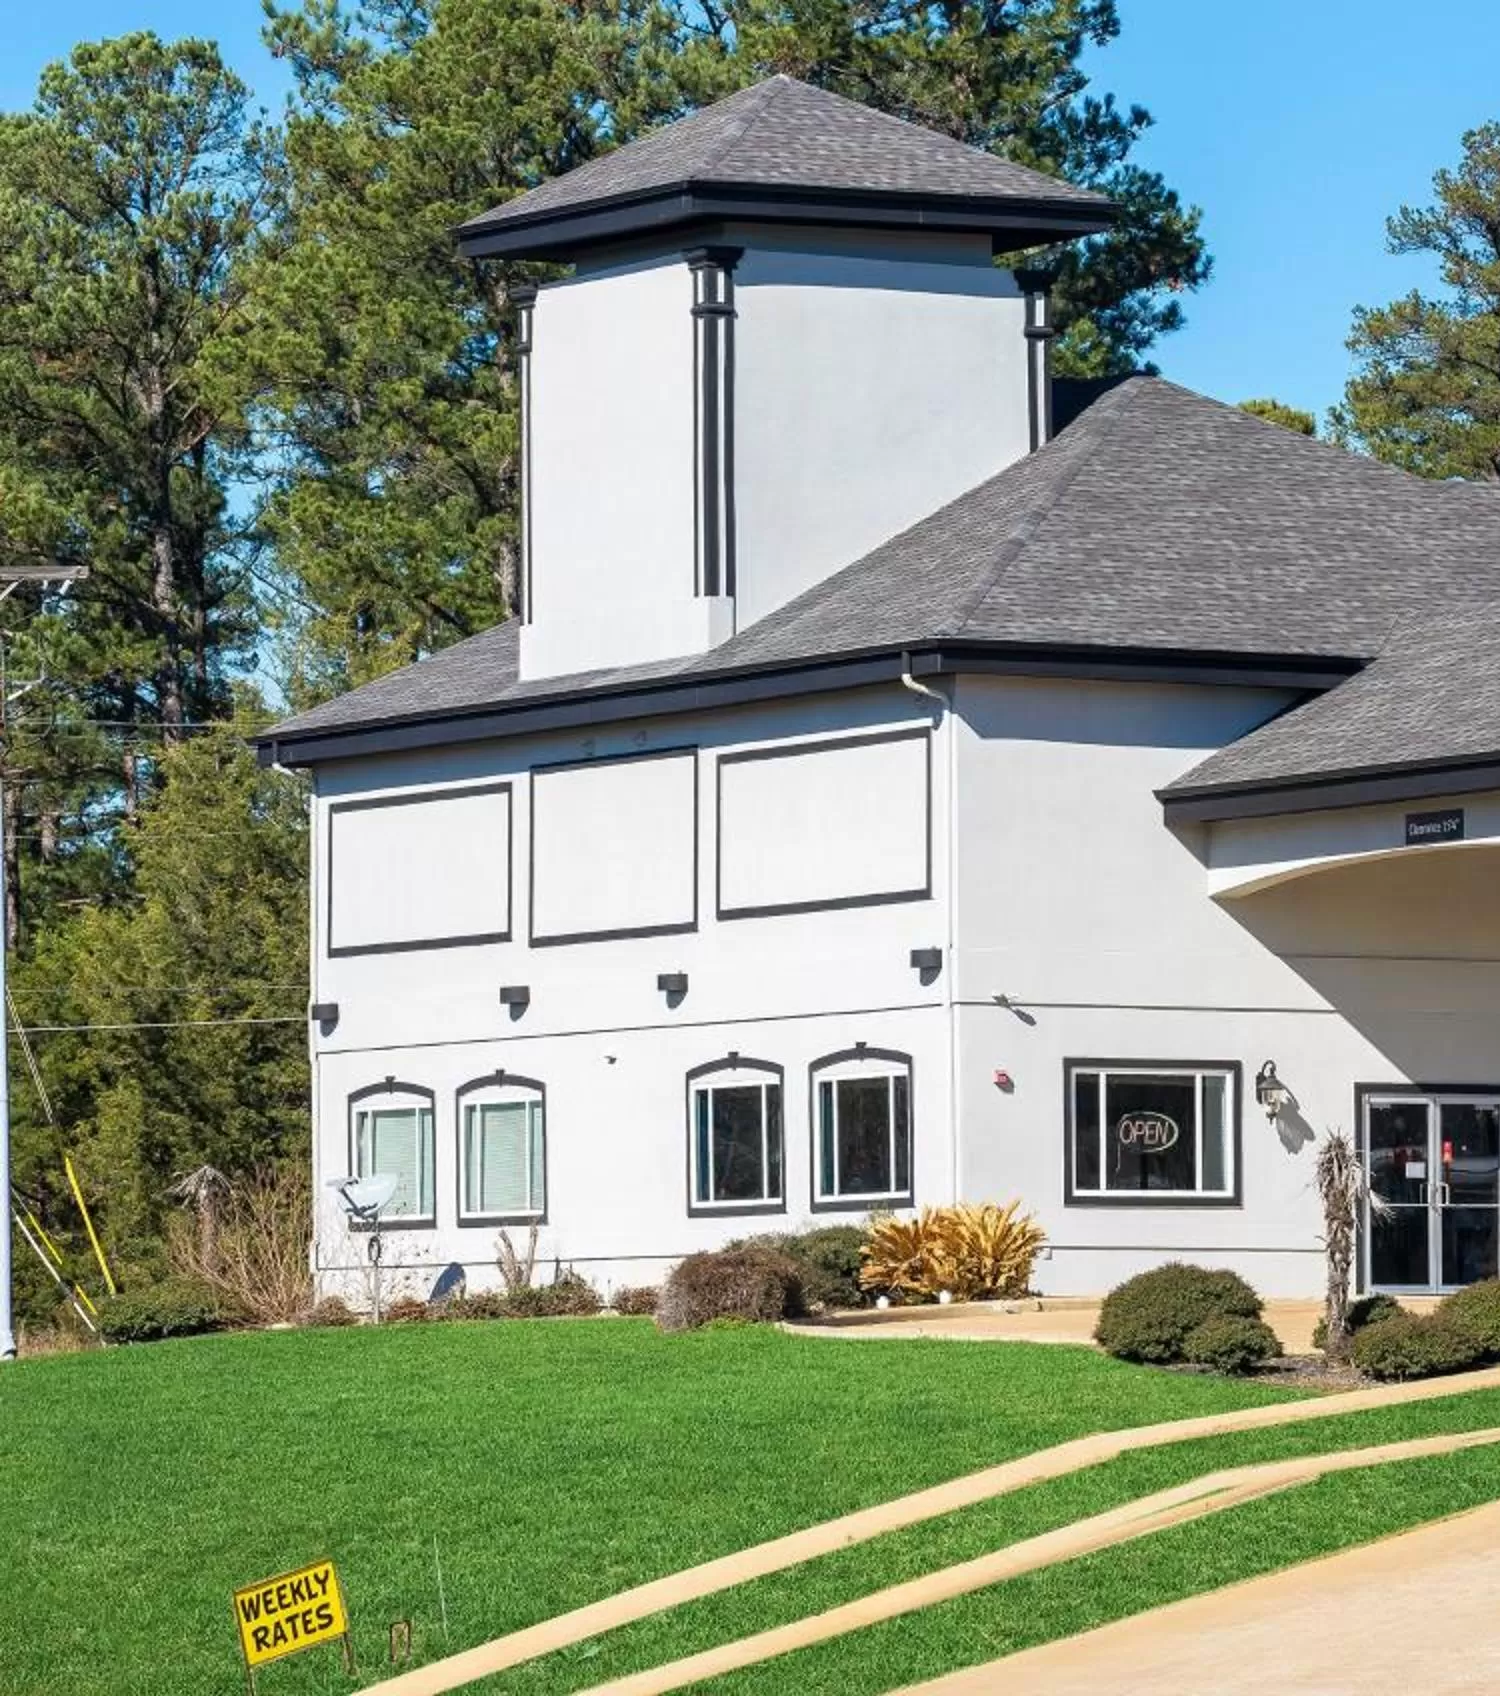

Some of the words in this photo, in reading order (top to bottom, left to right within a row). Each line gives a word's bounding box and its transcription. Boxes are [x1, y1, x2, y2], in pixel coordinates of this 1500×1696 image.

[1119, 1120, 1169, 1144] OPEN
[240, 1569, 329, 1623] WEEKLY
[252, 1603, 333, 1652] RATES
